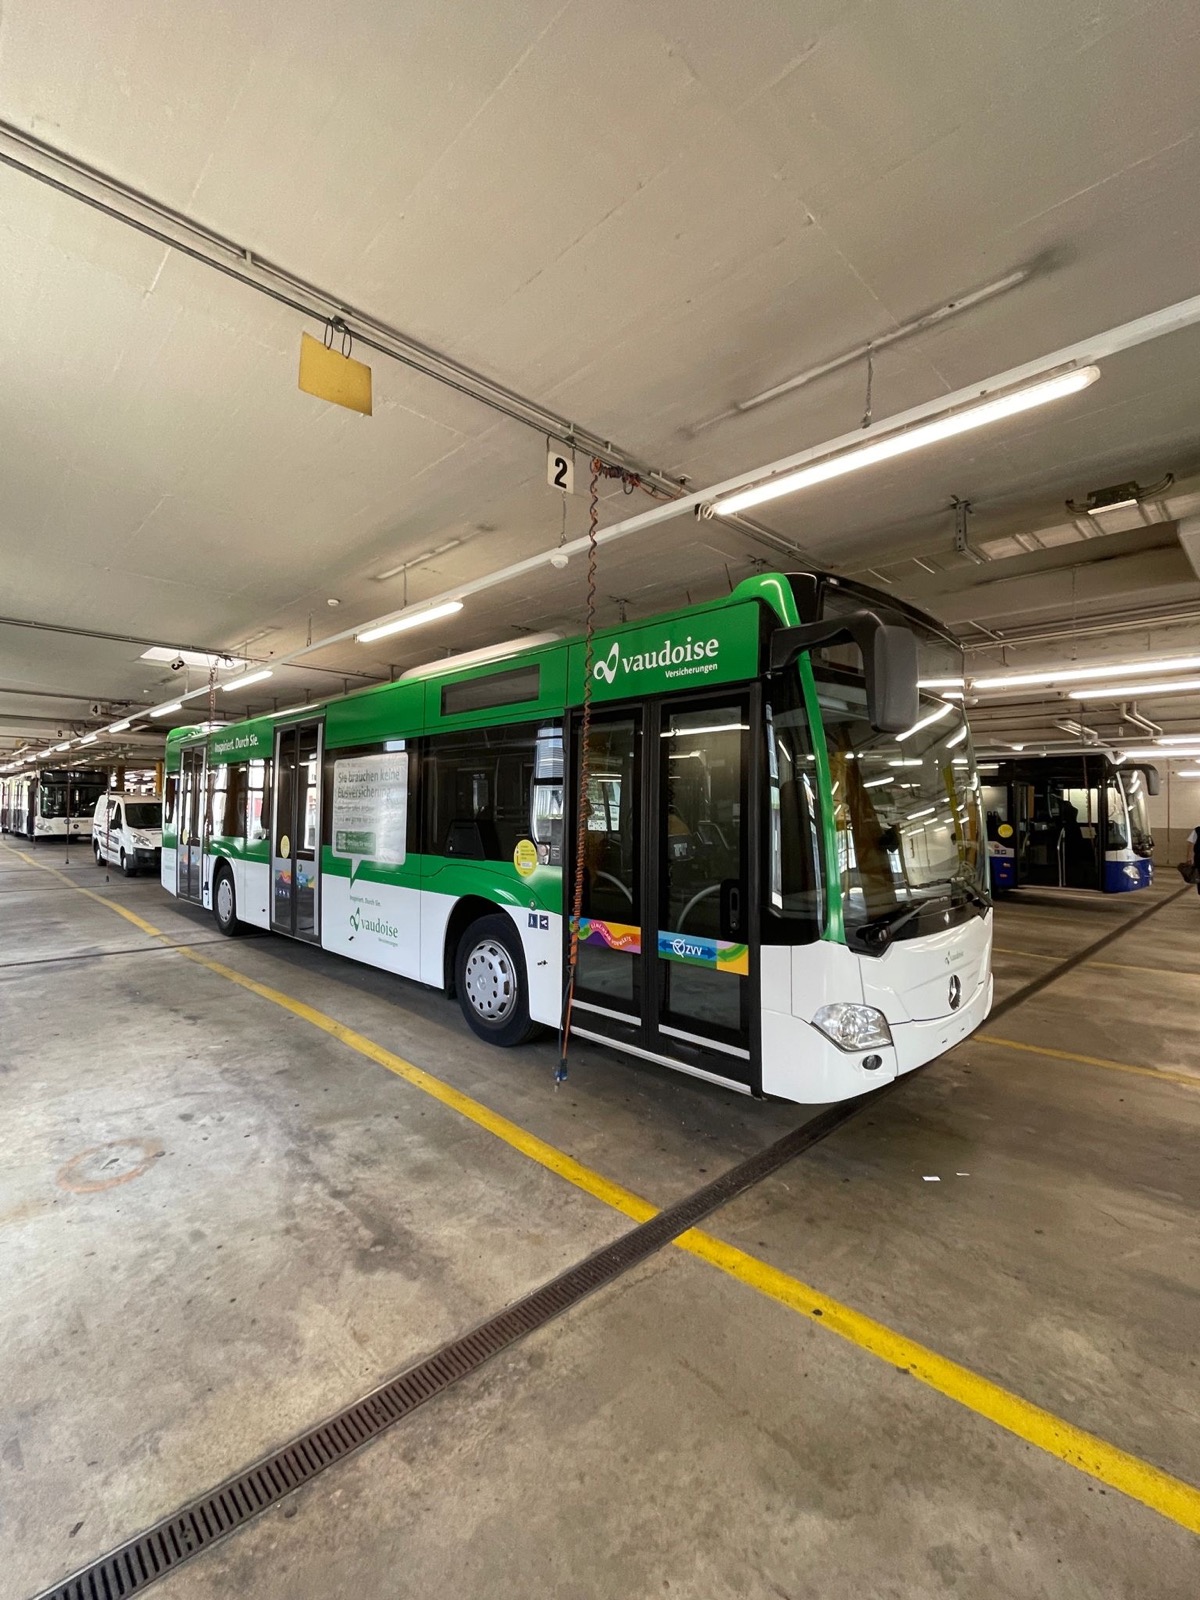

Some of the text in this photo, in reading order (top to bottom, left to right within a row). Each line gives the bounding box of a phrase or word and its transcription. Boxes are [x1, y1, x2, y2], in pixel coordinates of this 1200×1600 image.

[554, 457, 568, 489] 2
[621, 636, 719, 674] vaudoise
[171, 660, 185, 671] 3
[665, 663, 718, 679] Versicherungen
[92, 705, 98, 714] 4
[57, 730, 63, 738] 5
[235, 735, 250, 749] Durch
[348, 770, 379, 783] brauchen
[360, 918, 399, 938] vaudoise
[685, 944, 702, 956] ZVV
